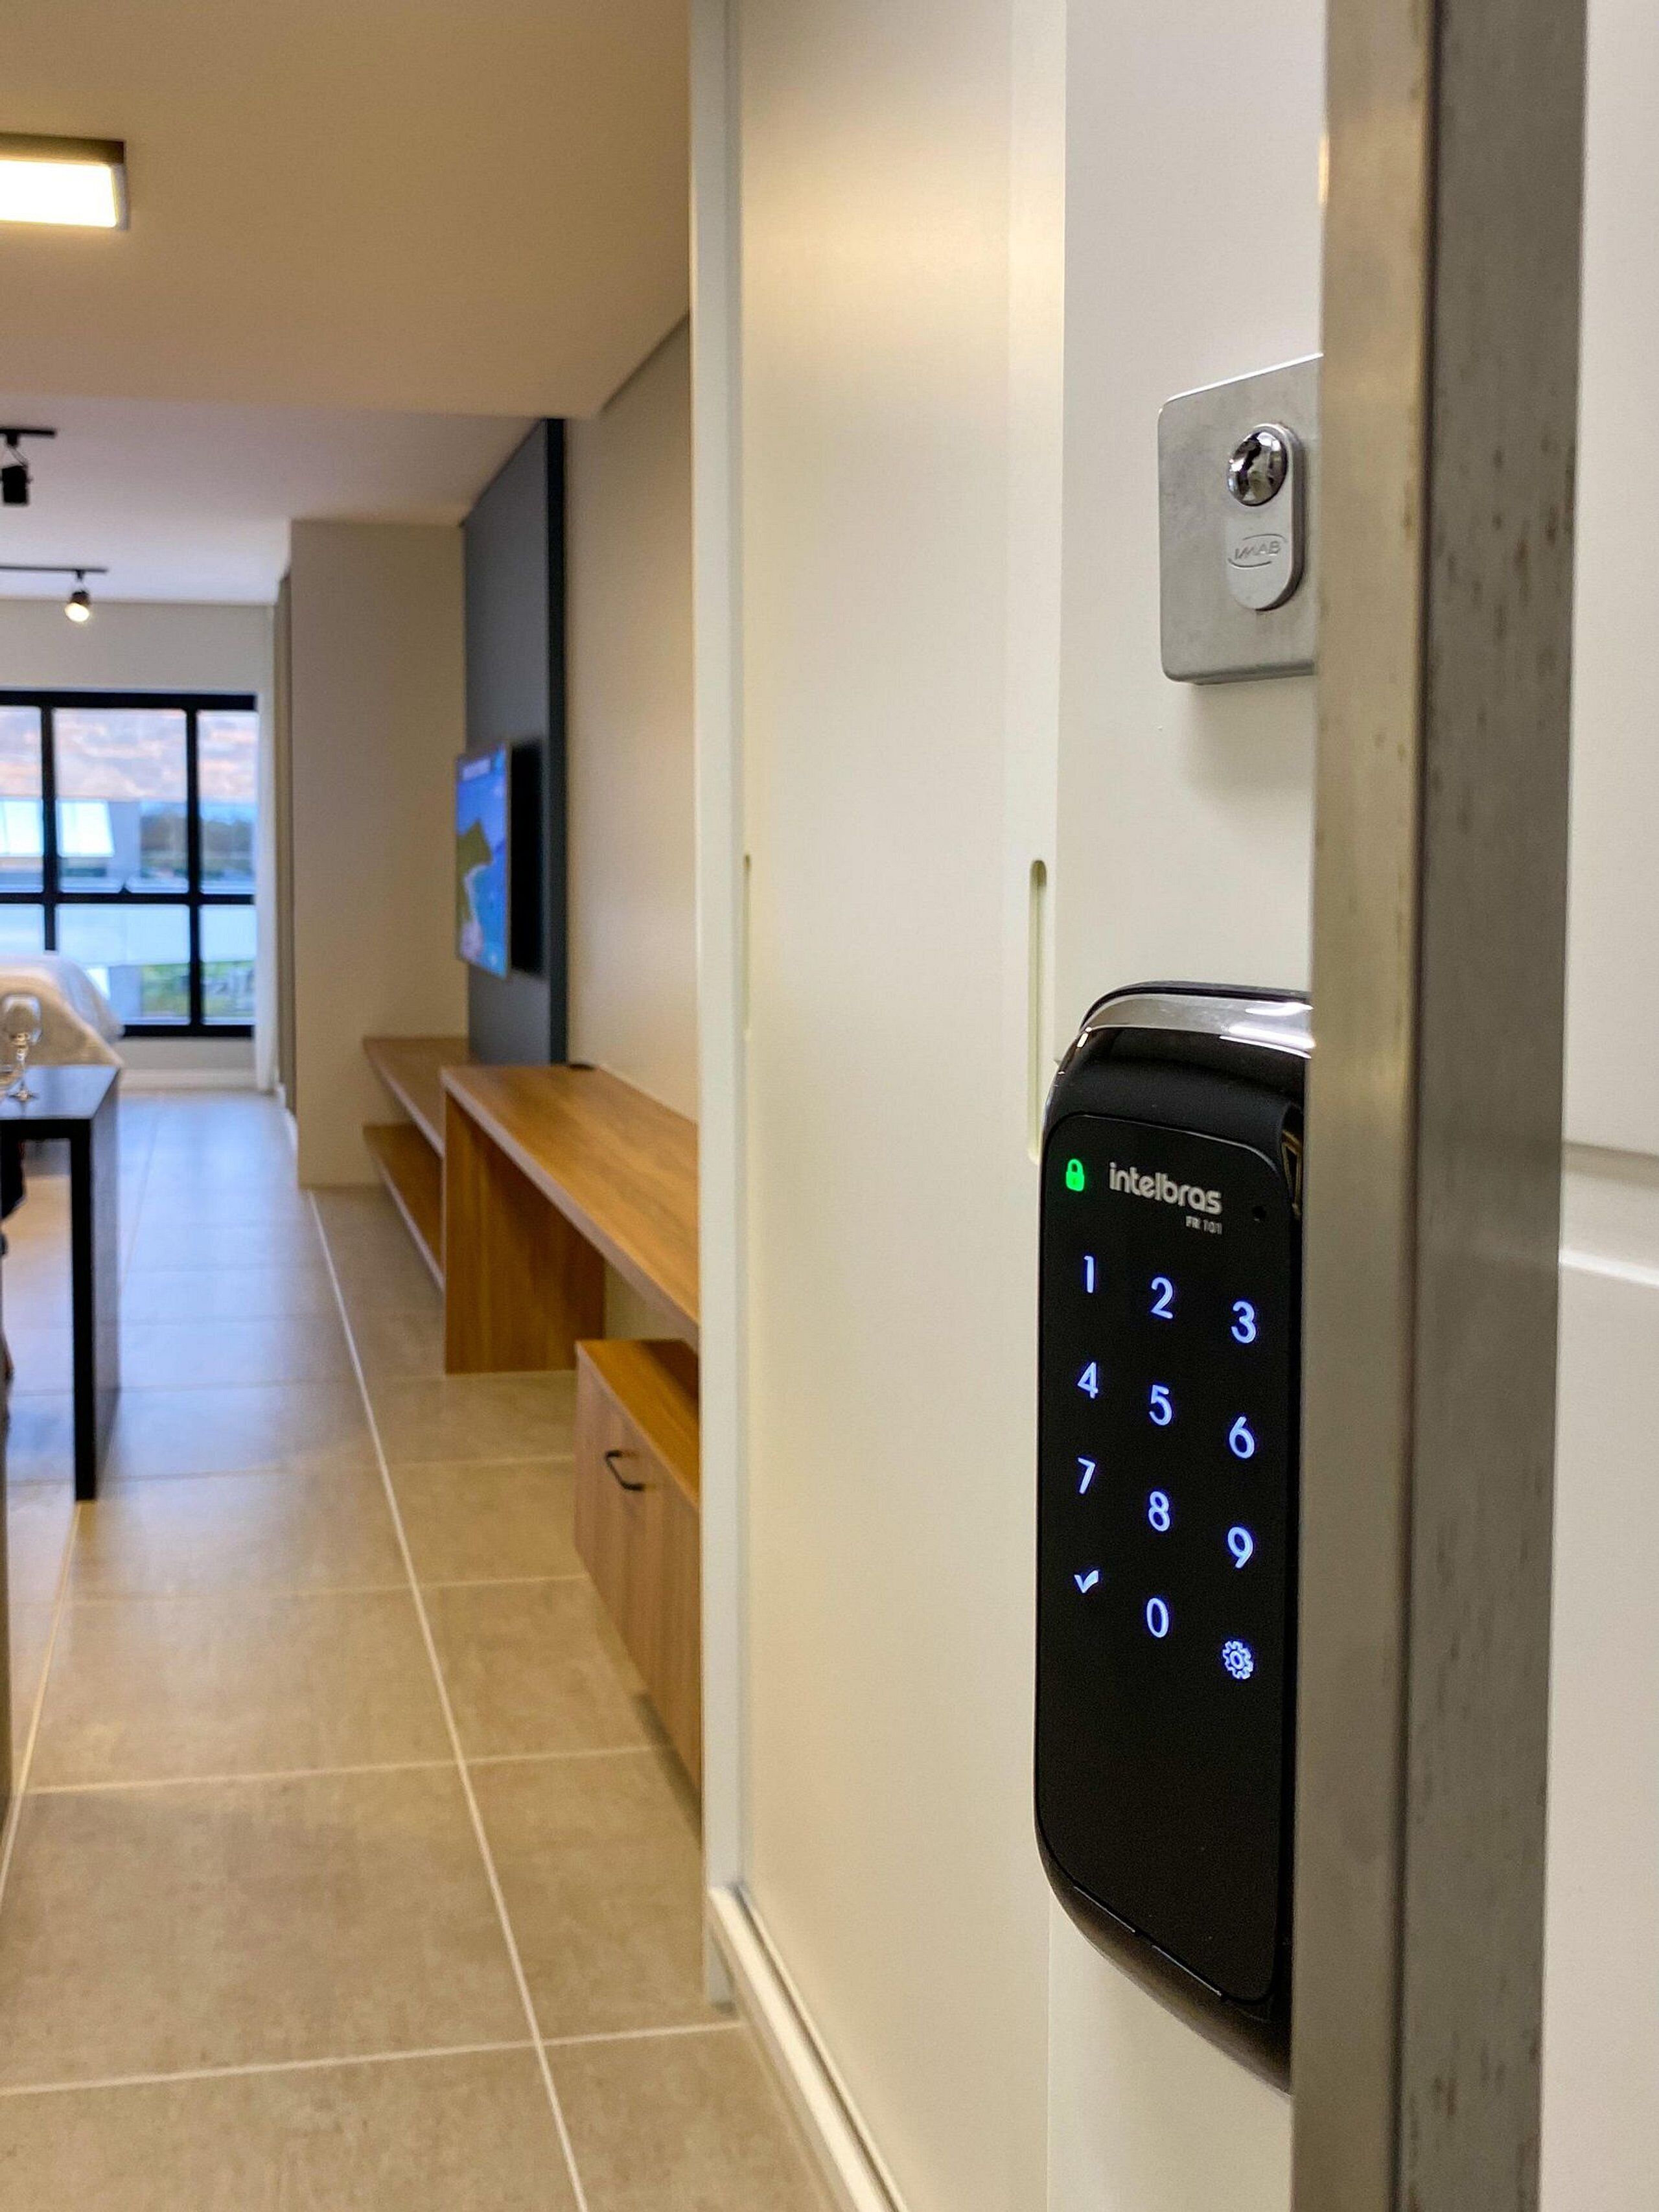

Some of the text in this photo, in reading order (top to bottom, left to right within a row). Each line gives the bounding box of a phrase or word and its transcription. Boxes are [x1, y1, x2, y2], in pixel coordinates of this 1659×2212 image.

[1109, 1161, 1222, 1215] intelbras
[1185, 1215, 1223, 1235] FR 101
[1083, 1255, 1258, 1344] 1 2 3
[1077, 1361, 1256, 1460] 4 5 6
[1076, 1456, 1255, 1569] 7 8 9
[1145, 1597, 1170, 1638] 0
